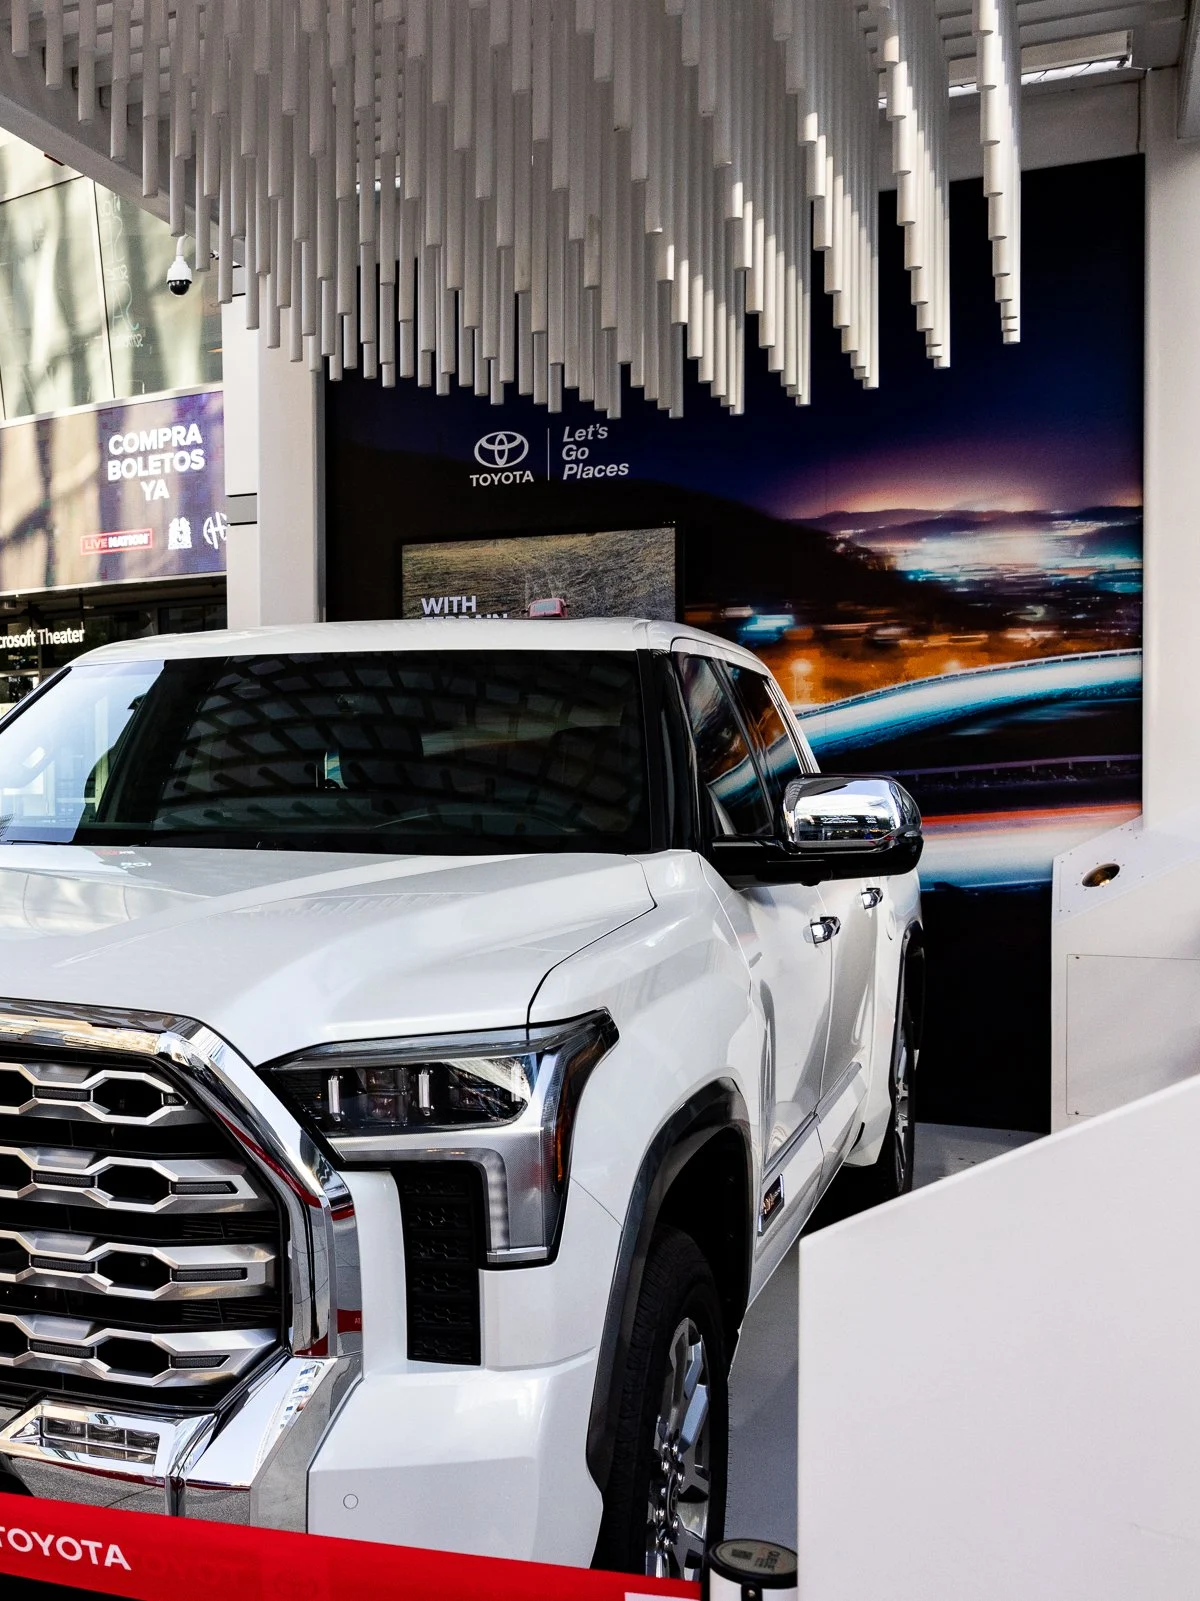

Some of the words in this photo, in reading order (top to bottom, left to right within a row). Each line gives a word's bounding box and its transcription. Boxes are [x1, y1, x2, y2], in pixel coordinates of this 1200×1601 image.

[108, 423, 203, 455] COMPRA
[562, 424, 609, 442] Let's
[561, 444, 590, 461] Go
[107, 448, 206, 481] BOLETOS
[562, 462, 630, 480] Places
[469, 470, 535, 487] TOYOTA
[140, 478, 170, 502] YA
[85, 538, 108, 549] LIVE
[108, 532, 150, 548] NATION
[420, 595, 477, 614] WITH
[37, 627, 86, 646] Theater
